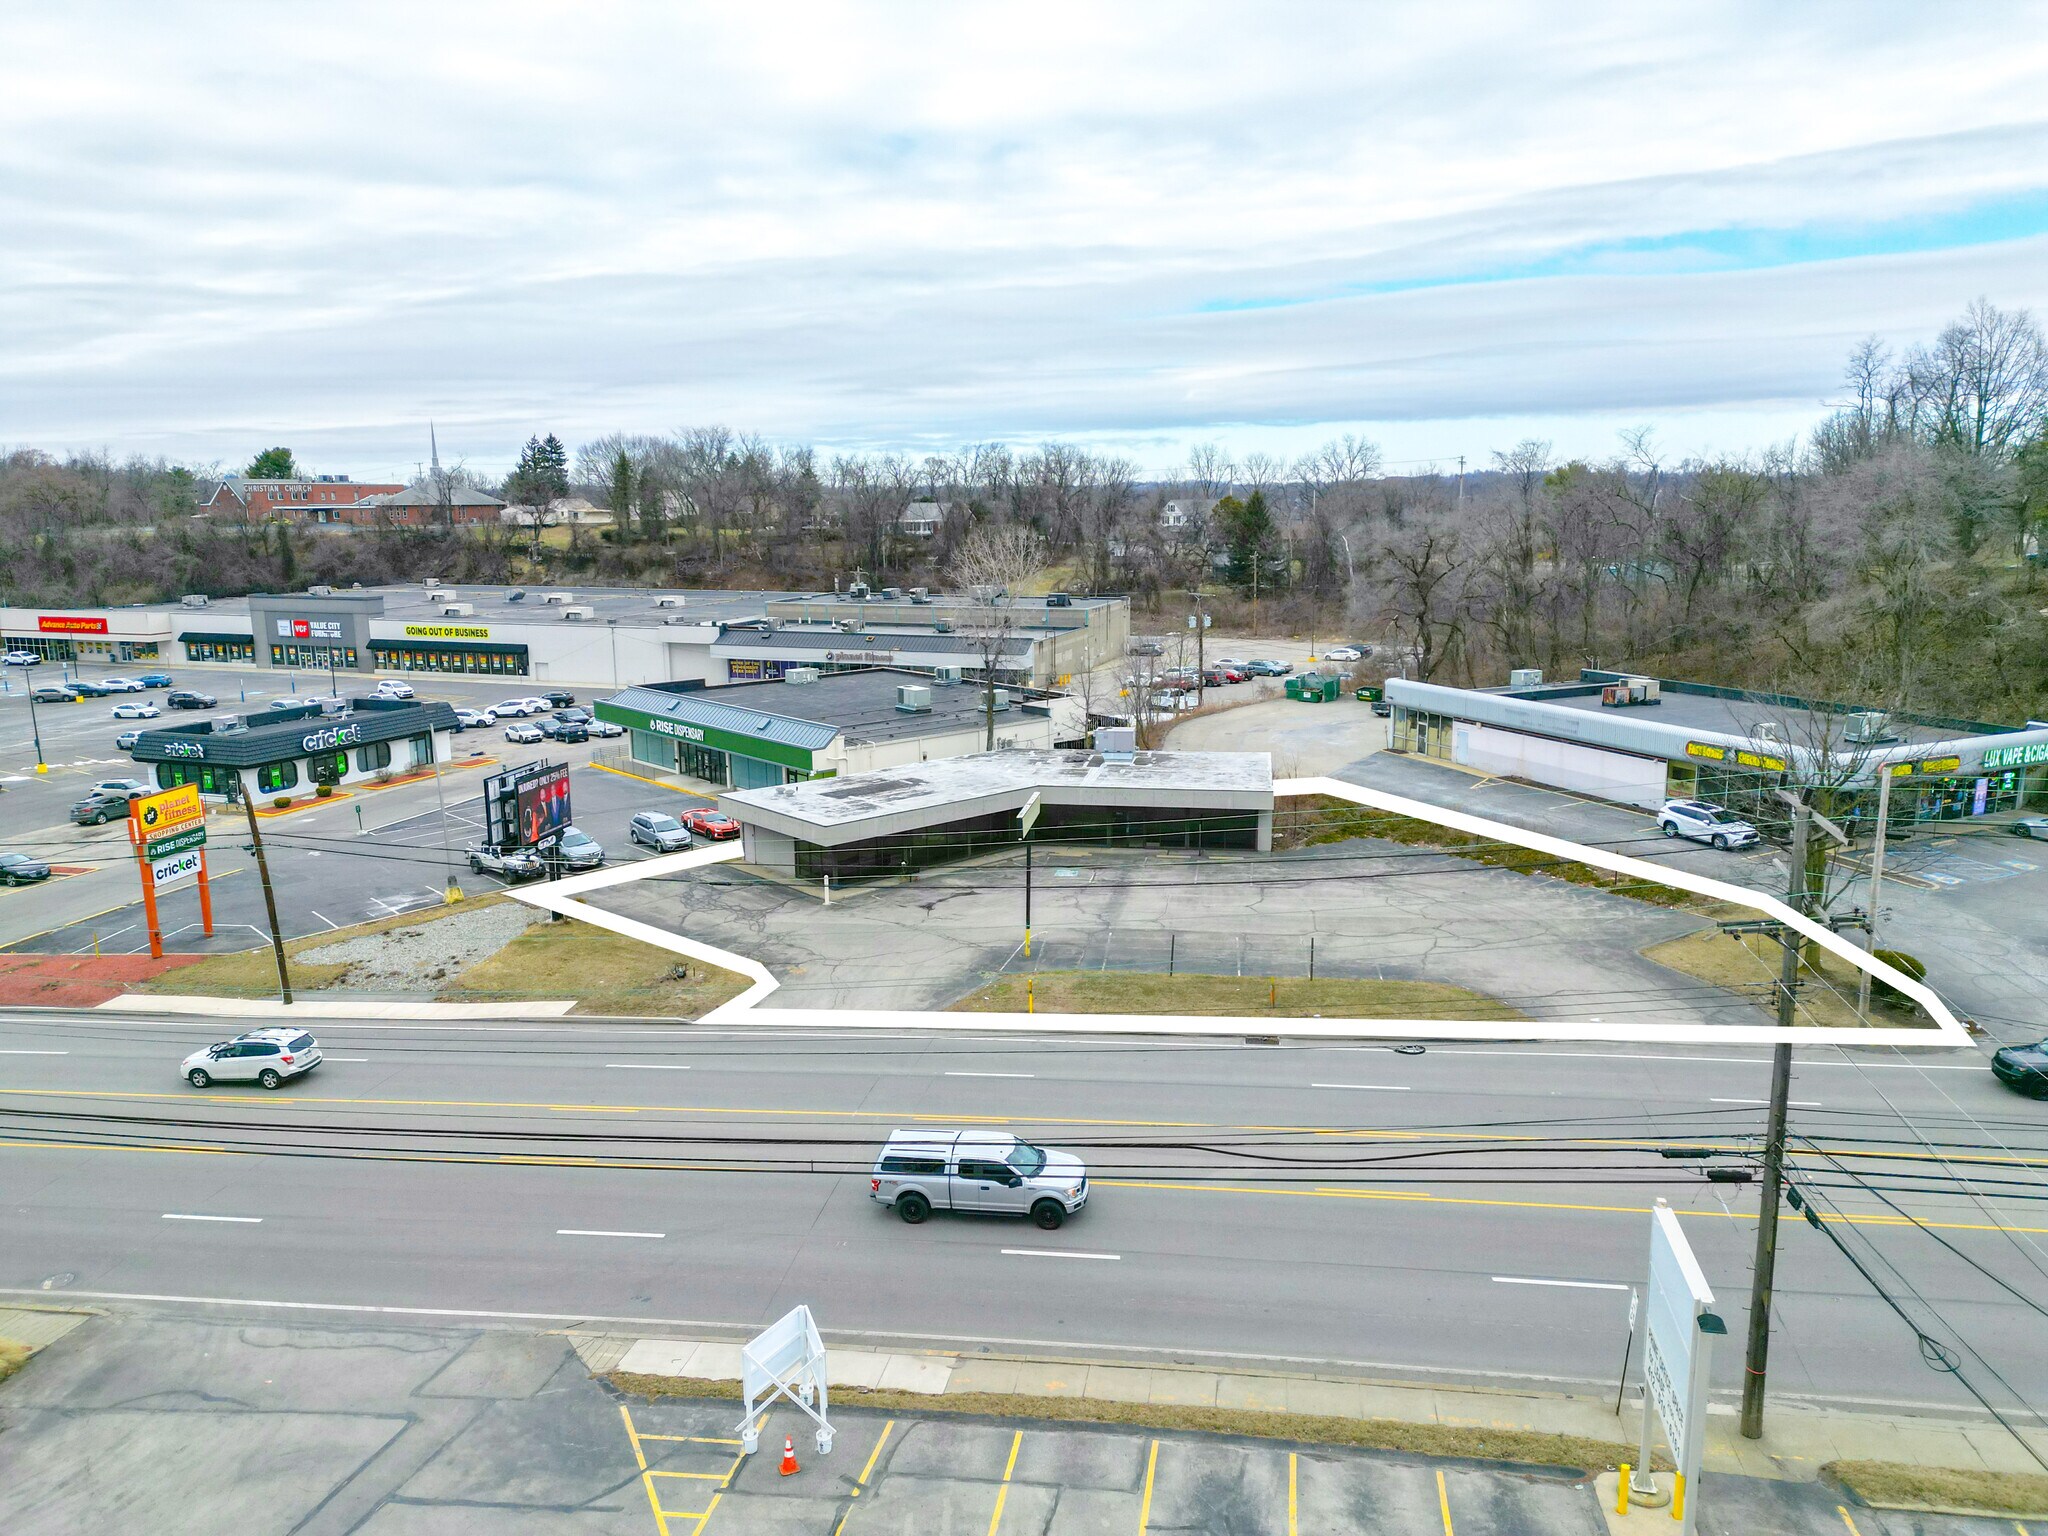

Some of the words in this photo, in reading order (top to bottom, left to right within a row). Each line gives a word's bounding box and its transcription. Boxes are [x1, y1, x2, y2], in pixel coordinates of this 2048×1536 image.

[243, 484, 279, 493] CHRISTIAN
[284, 484, 313, 493] CHURCH
[41, 620, 66, 630] Advance
[80, 622, 96, 630] Parts
[294, 624, 308, 633] VCF
[309, 621, 327, 630] VALUE
[327, 622, 341, 630] CITY
[405, 626, 428, 636] GOING
[428, 627, 443, 636] OUT
[444, 628, 454, 637] OF
[454, 628, 489, 638] BUSINESS
[302, 724, 361, 752] cricket
[655, 719, 674, 735] RISE
[674, 723, 705, 742] DISPENSARY
[164, 741, 204, 759] cricket
[1984, 749, 2001, 768] LUX
[2002, 746, 2025, 766] VAPE
[159, 795, 191, 815] planet
[164, 804, 198, 821] fitness
[149, 825, 180, 840] SHOPPING
[180, 819, 202, 831] CENTER
[157, 841, 176, 855] RISE
[175, 830, 205, 847] DISPENSARY
[155, 854, 198, 880] cricket
